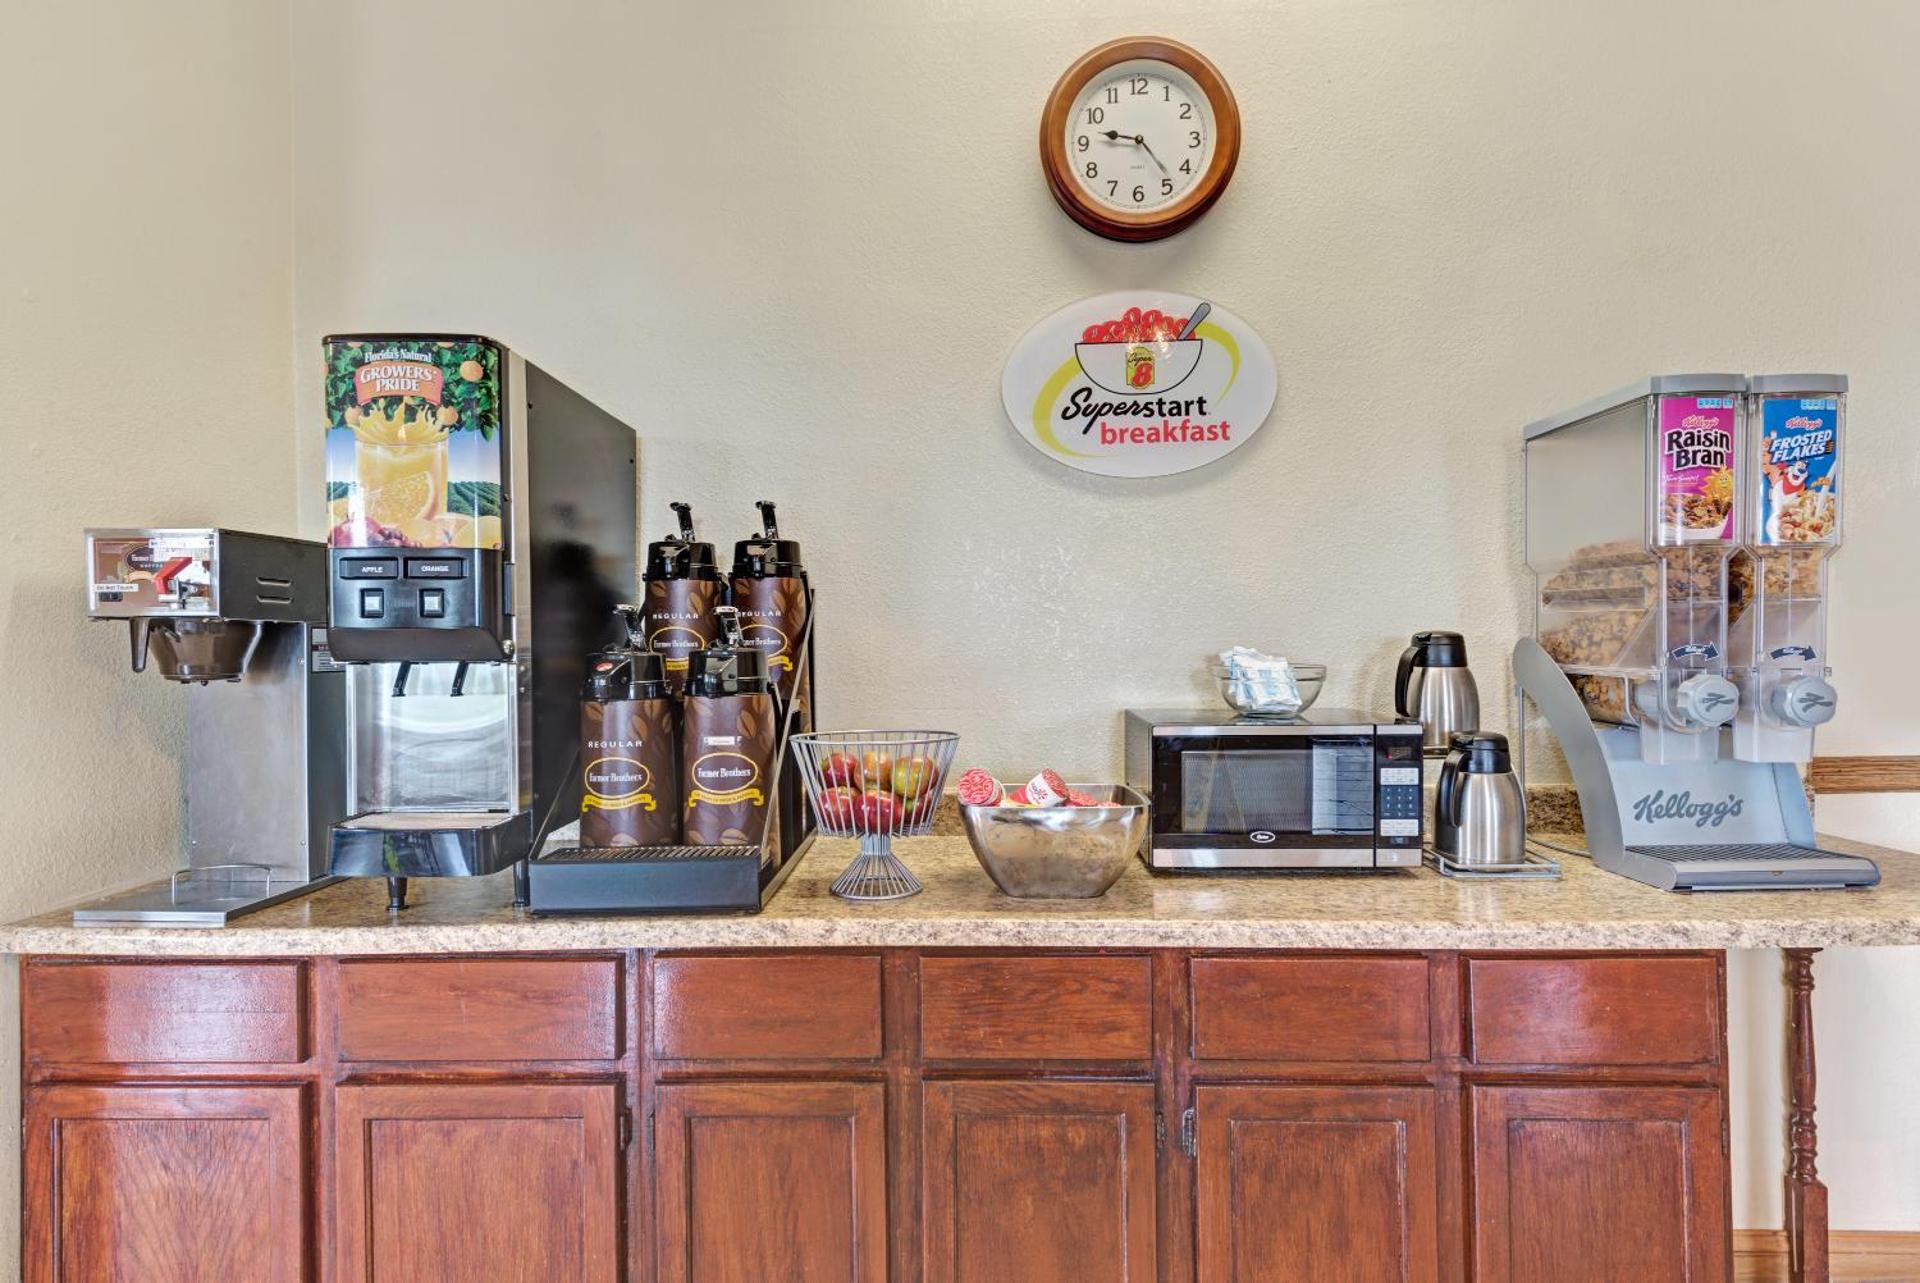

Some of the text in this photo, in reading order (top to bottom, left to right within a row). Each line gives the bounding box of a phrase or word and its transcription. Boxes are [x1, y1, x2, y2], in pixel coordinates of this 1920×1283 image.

[1129, 78, 1149, 95] 12
[1163, 86, 1170, 101] 1
[1105, 88, 1119, 104] 11
[1087, 107, 1104, 124] 10
[1179, 103, 1192, 120] 2
[1078, 135, 1090, 152] 9
[1189, 131, 1201, 148] 3
[1086, 162, 1098, 178] 8
[1179, 159, 1191, 174] 4
[1107, 180, 1118, 196] 7
[1133, 185, 1145, 202] 6
[1161, 179, 1173, 195] 5
[400, 349, 432, 363] Natural
[375, 378, 420, 392] PRIDE
[1060, 387, 1207, 435] Superstart
[1100, 419, 1231, 445] breakfast
[1667, 430, 1730, 450] Raisin
[1770, 429, 1832, 452] FROSTED
[1675, 449, 1724, 468] Bran
[1773, 441, 1825, 463] FLAKES
[588, 740, 643, 748] REGULAR
[719, 768, 751, 778] Brothers
[1632, 789, 1744, 827] Kellogg's
